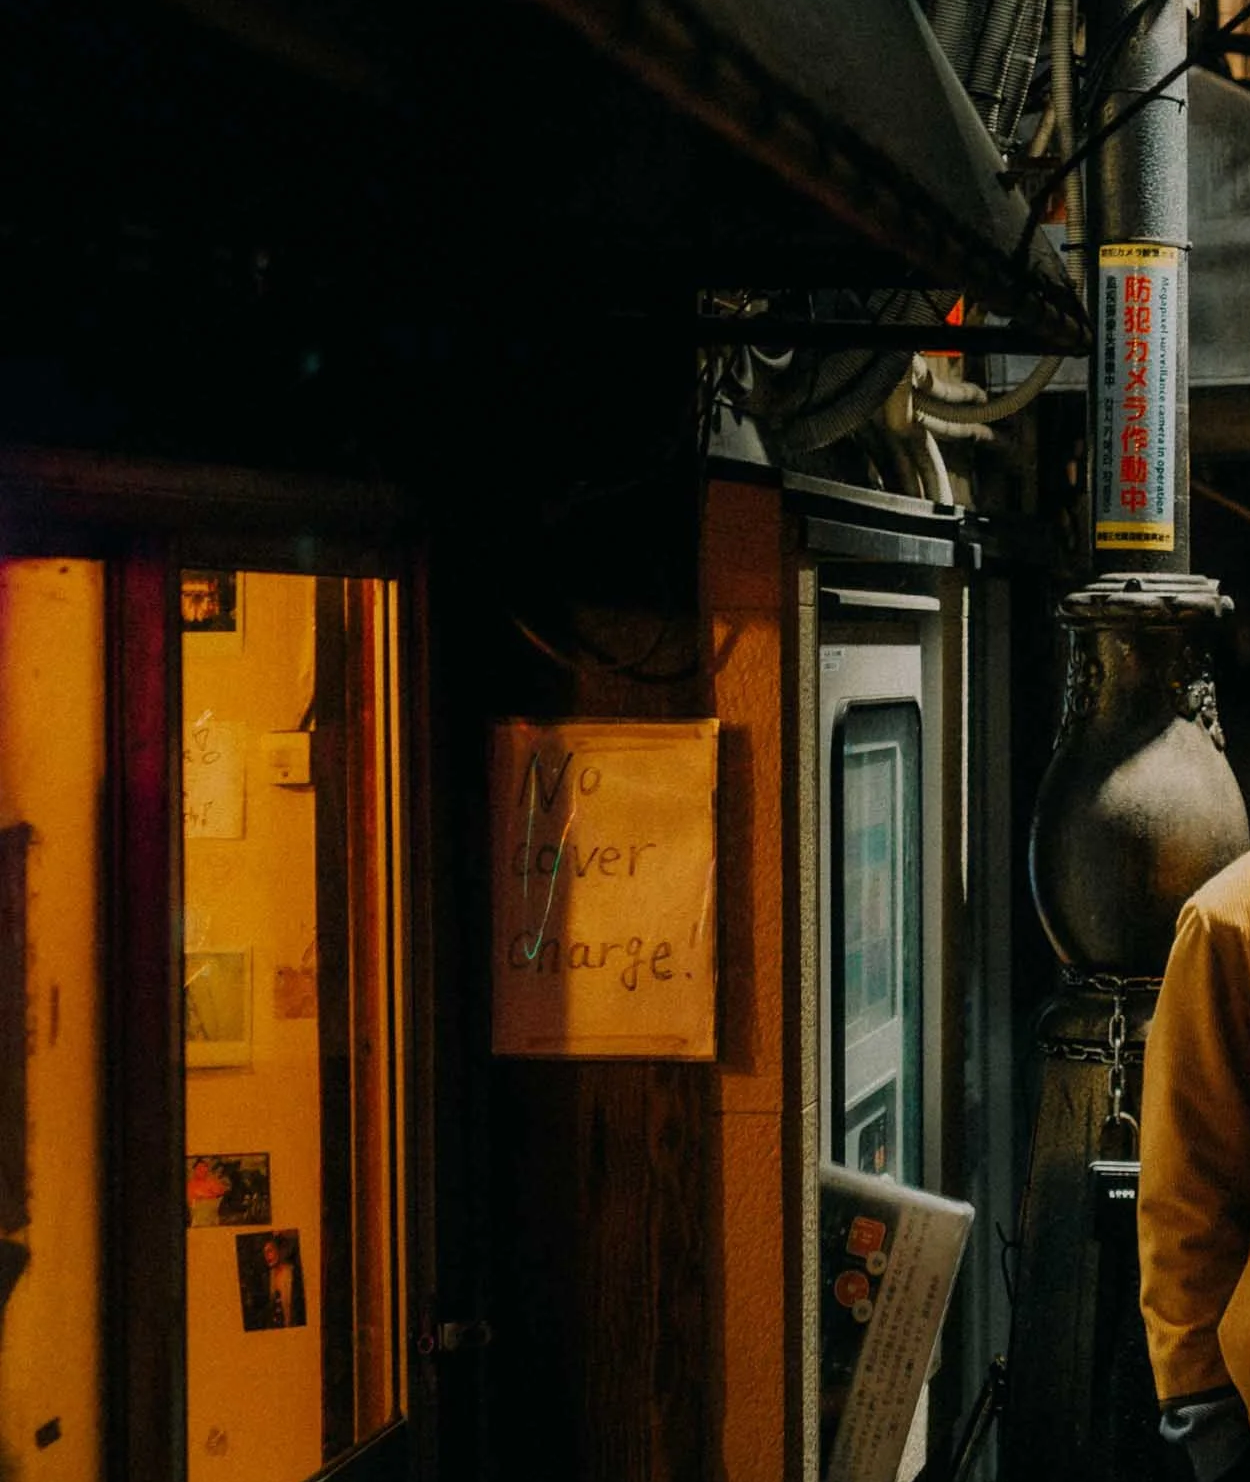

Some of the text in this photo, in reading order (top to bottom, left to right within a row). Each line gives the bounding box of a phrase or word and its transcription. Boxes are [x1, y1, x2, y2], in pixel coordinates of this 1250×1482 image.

[1120, 274, 1152, 514] 防犯カメラ作動中
[1157, 405, 1168, 444] camera
[1155, 460, 1167, 515] operation
[517, 750, 602, 814] No
[510, 840, 657, 879] cover
